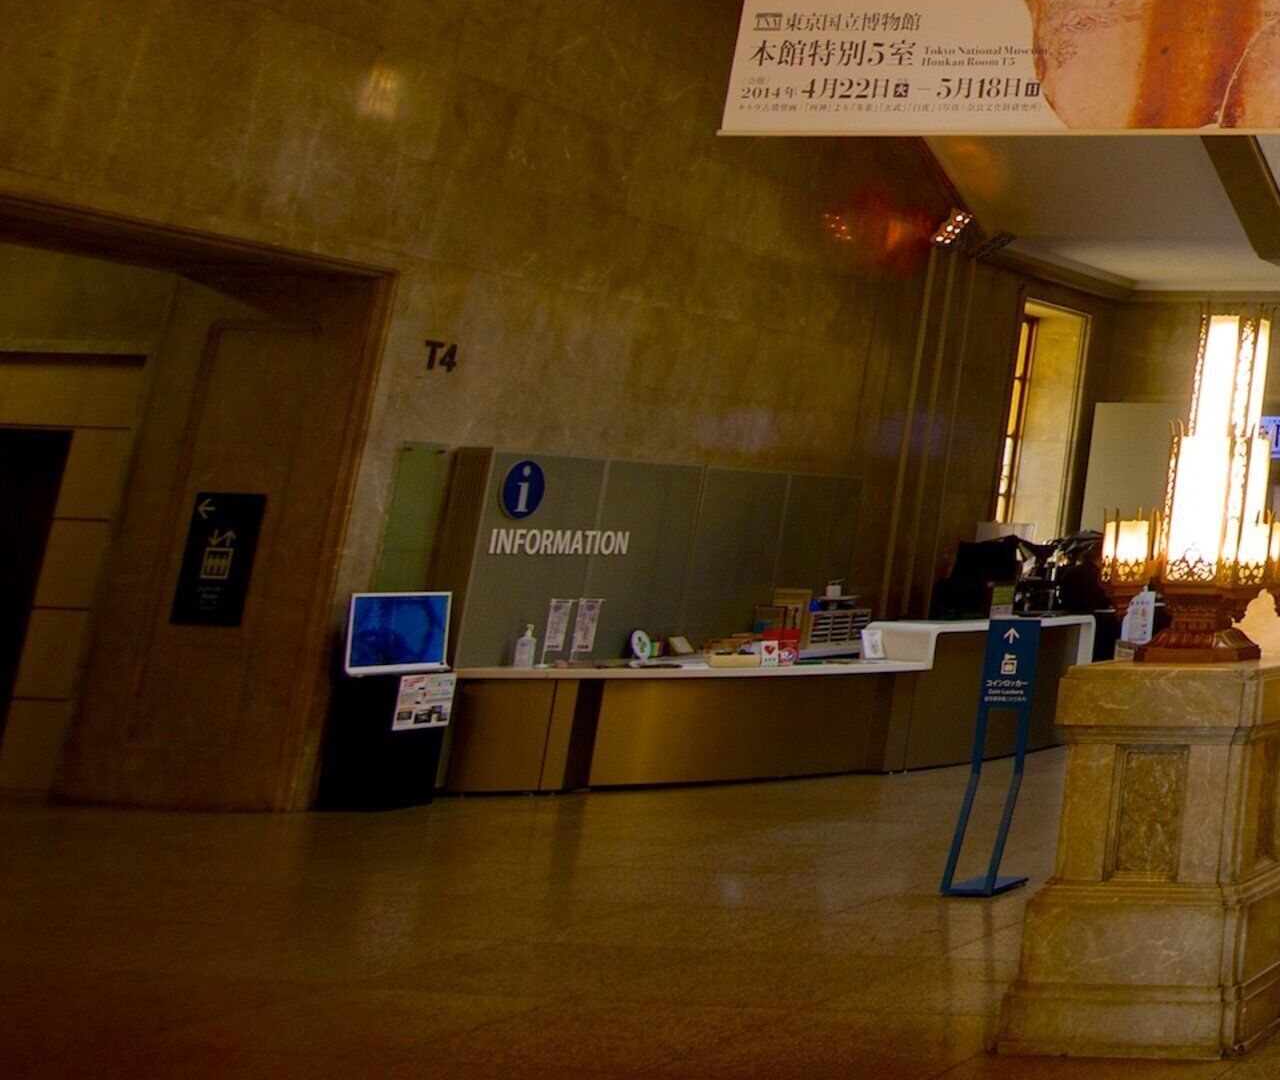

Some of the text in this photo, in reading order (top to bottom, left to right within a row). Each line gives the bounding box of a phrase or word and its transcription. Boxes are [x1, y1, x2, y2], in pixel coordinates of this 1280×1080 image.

[784, 11, 922, 32] 東京国立博物館
[748, 39, 917, 67] 本館特別5室
[920, 57, 965, 67] Honkan
[966, 57, 999, 67] Room
[924, 45, 956, 57] Tokyo
[957, 45, 1002, 56] National
[424, 339, 459, 373] T4
[487, 527, 631, 557] INFORMATION
